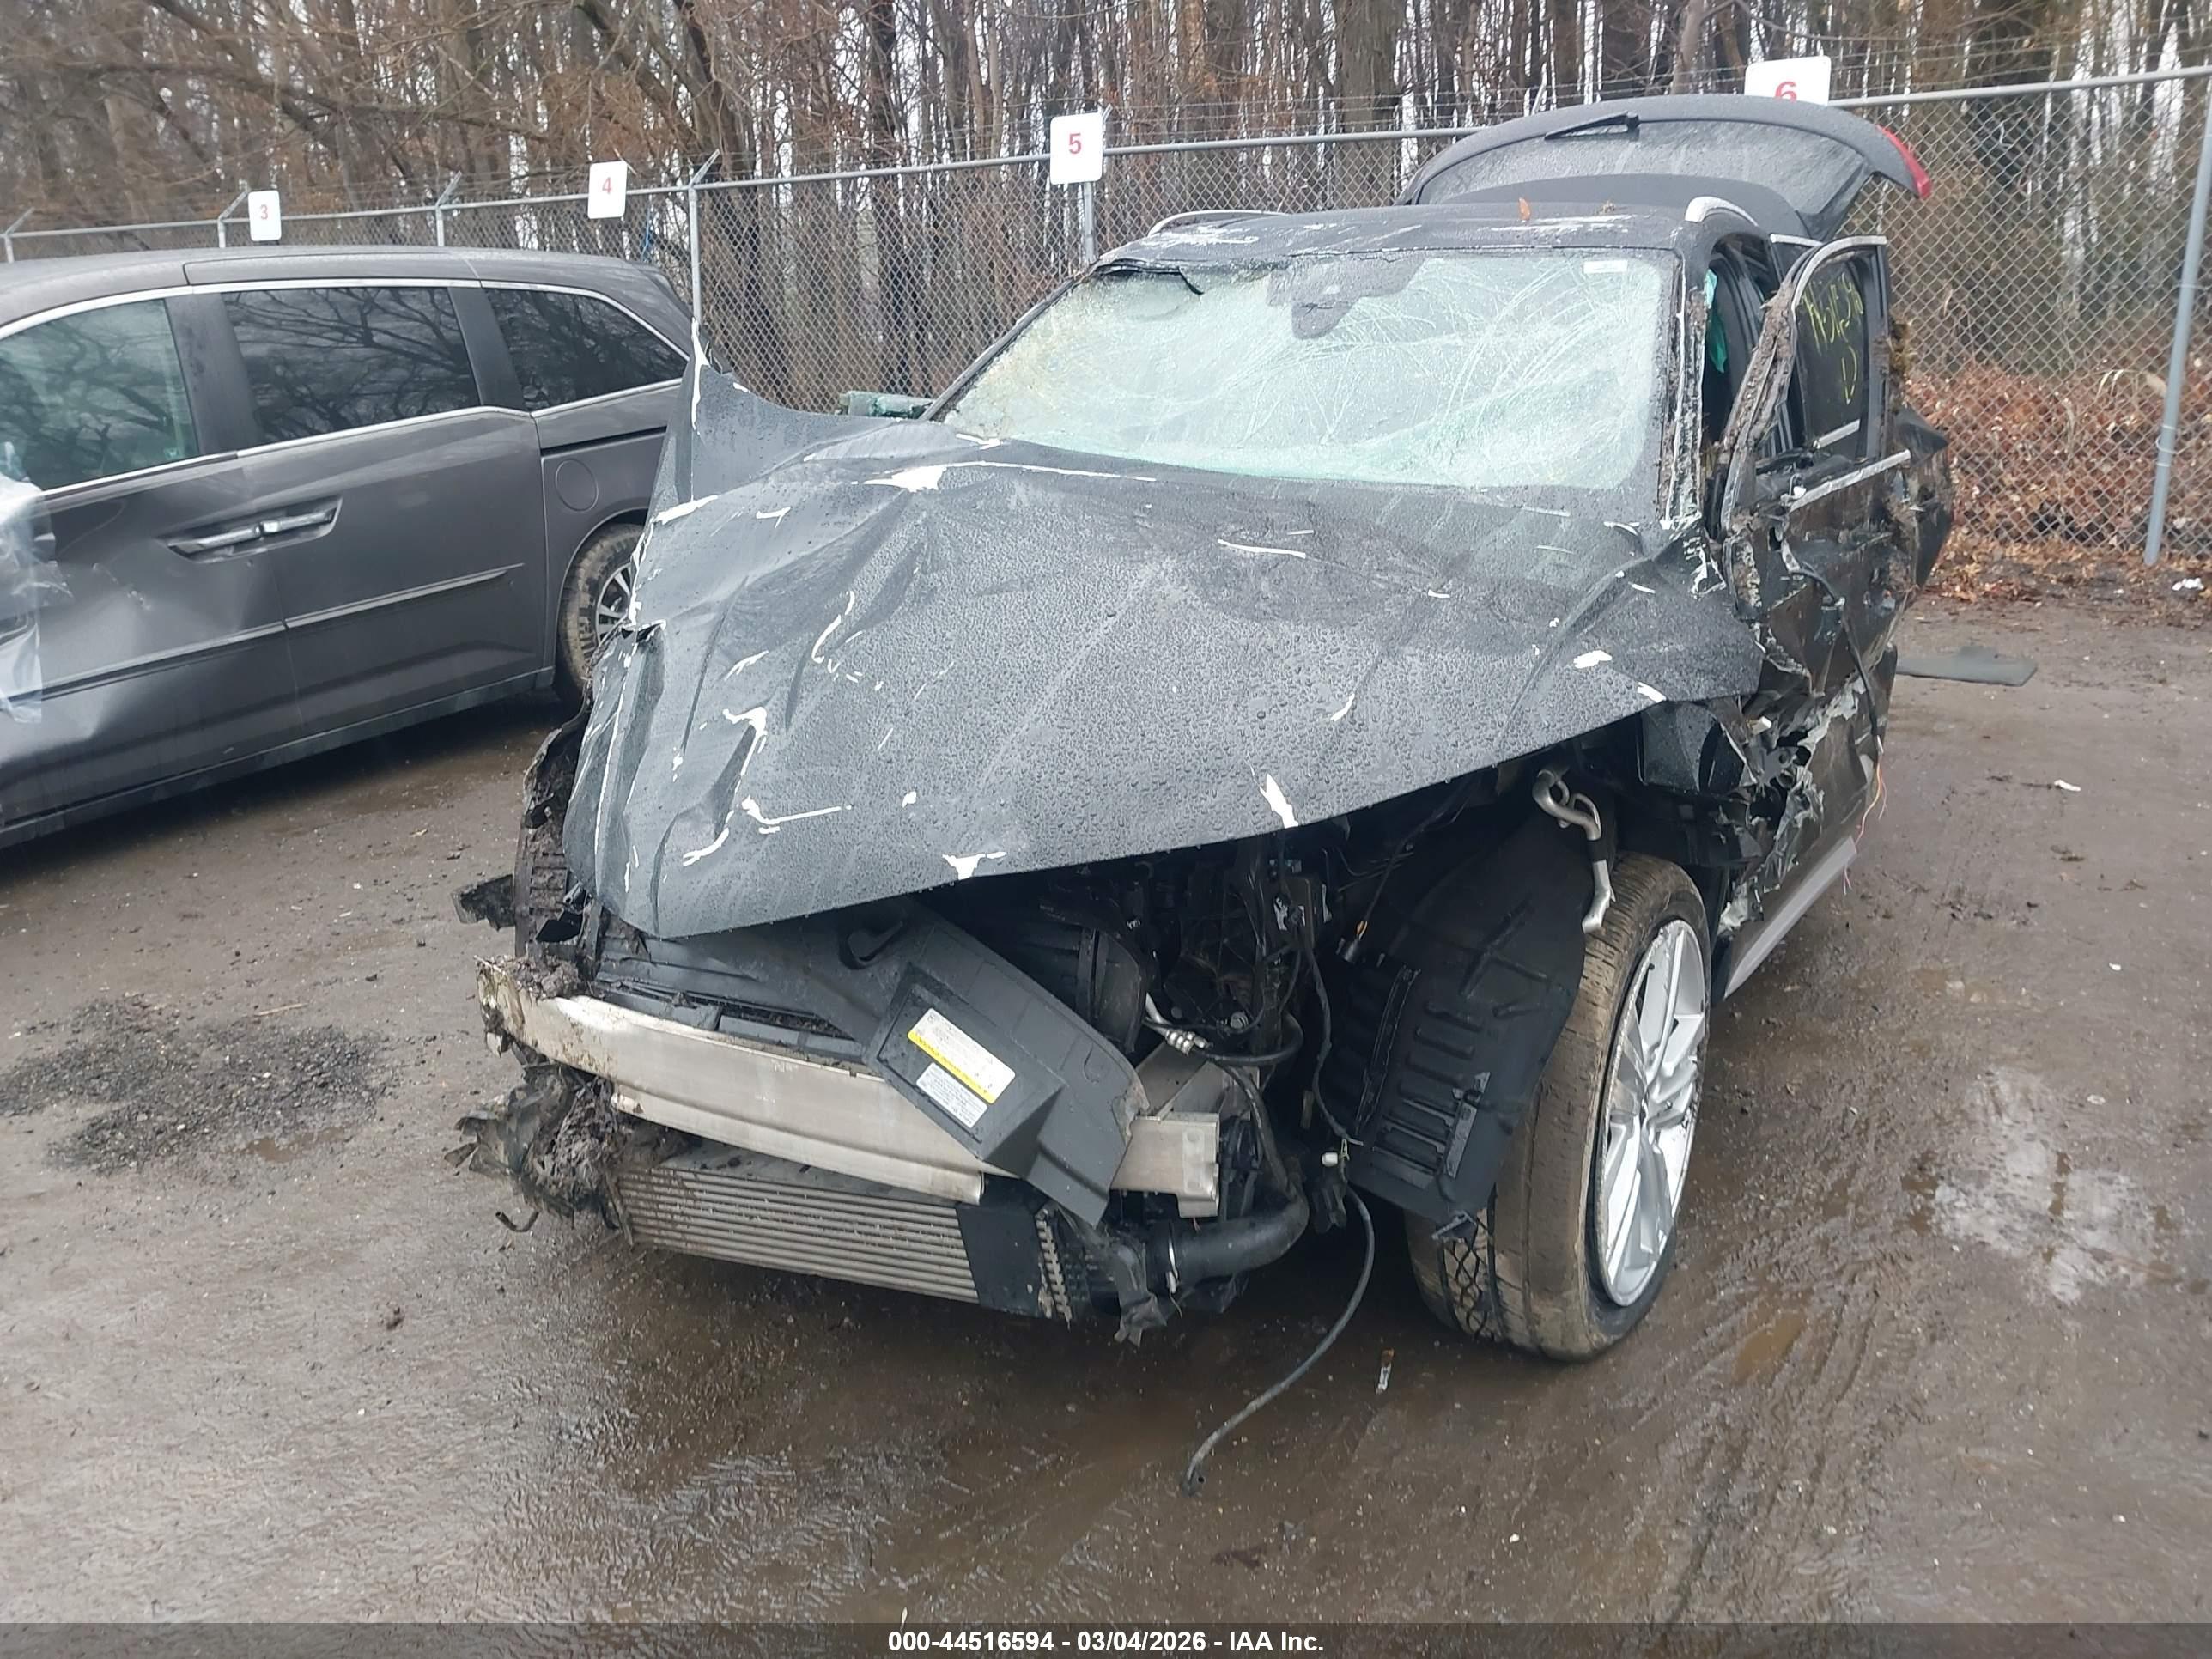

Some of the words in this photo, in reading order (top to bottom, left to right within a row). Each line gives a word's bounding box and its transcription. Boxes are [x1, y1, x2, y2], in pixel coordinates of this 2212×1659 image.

[1775, 81, 1797, 102] 6
[1068, 132, 1083, 155] 5
[602, 176, 612, 195] 4
[260, 204, 269, 221] 3
